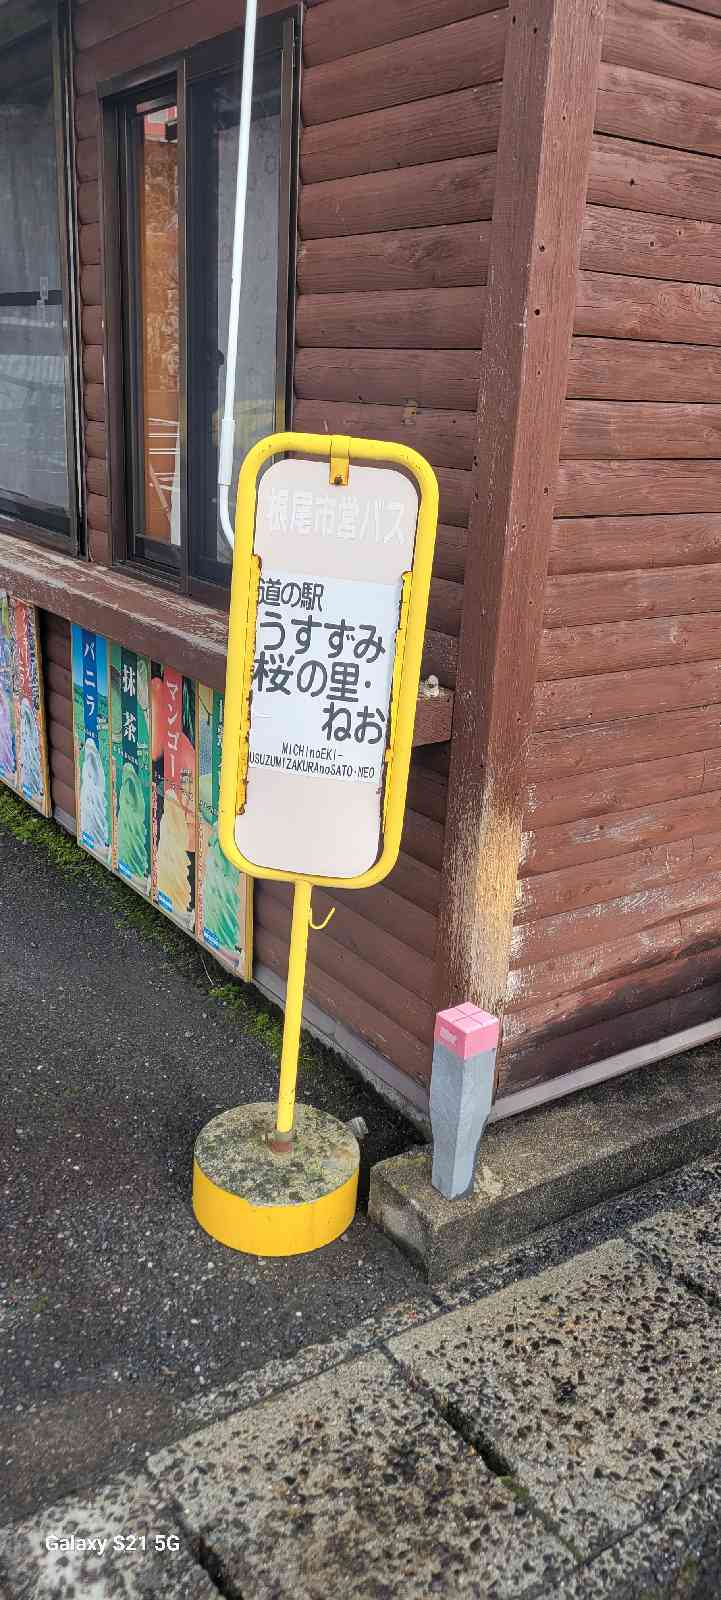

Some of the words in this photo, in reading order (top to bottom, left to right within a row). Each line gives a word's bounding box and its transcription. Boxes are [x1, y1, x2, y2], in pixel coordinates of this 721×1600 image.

[257, 577, 324, 612] 道の駅
[259, 611, 386, 663] うすずみ
[84, 641, 97, 717] バニラ
[121, 664, 137, 743] 抹茶
[166, 681, 180, 778] マンゴー
[321, 701, 386, 745] ねお
